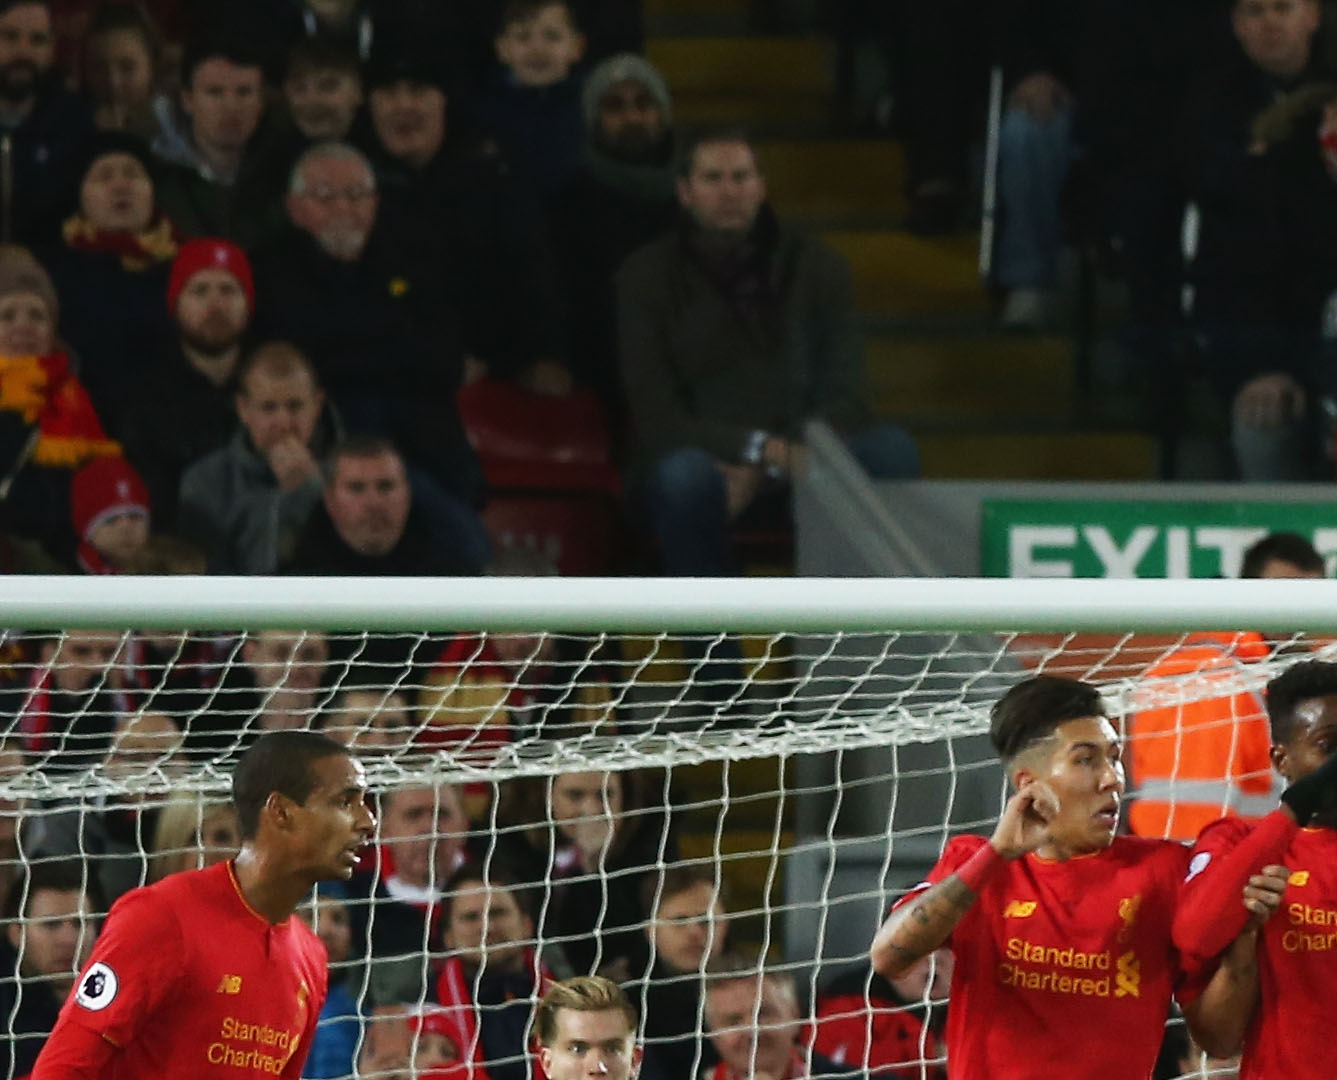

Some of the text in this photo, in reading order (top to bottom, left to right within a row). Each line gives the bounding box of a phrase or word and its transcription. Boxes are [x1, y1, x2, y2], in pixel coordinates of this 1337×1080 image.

[1008, 525, 1270, 578] EXIT
[1006, 937, 1110, 970] Standard
[999, 963, 1110, 997] Chartered
[221, 1016, 290, 1049] Standard
